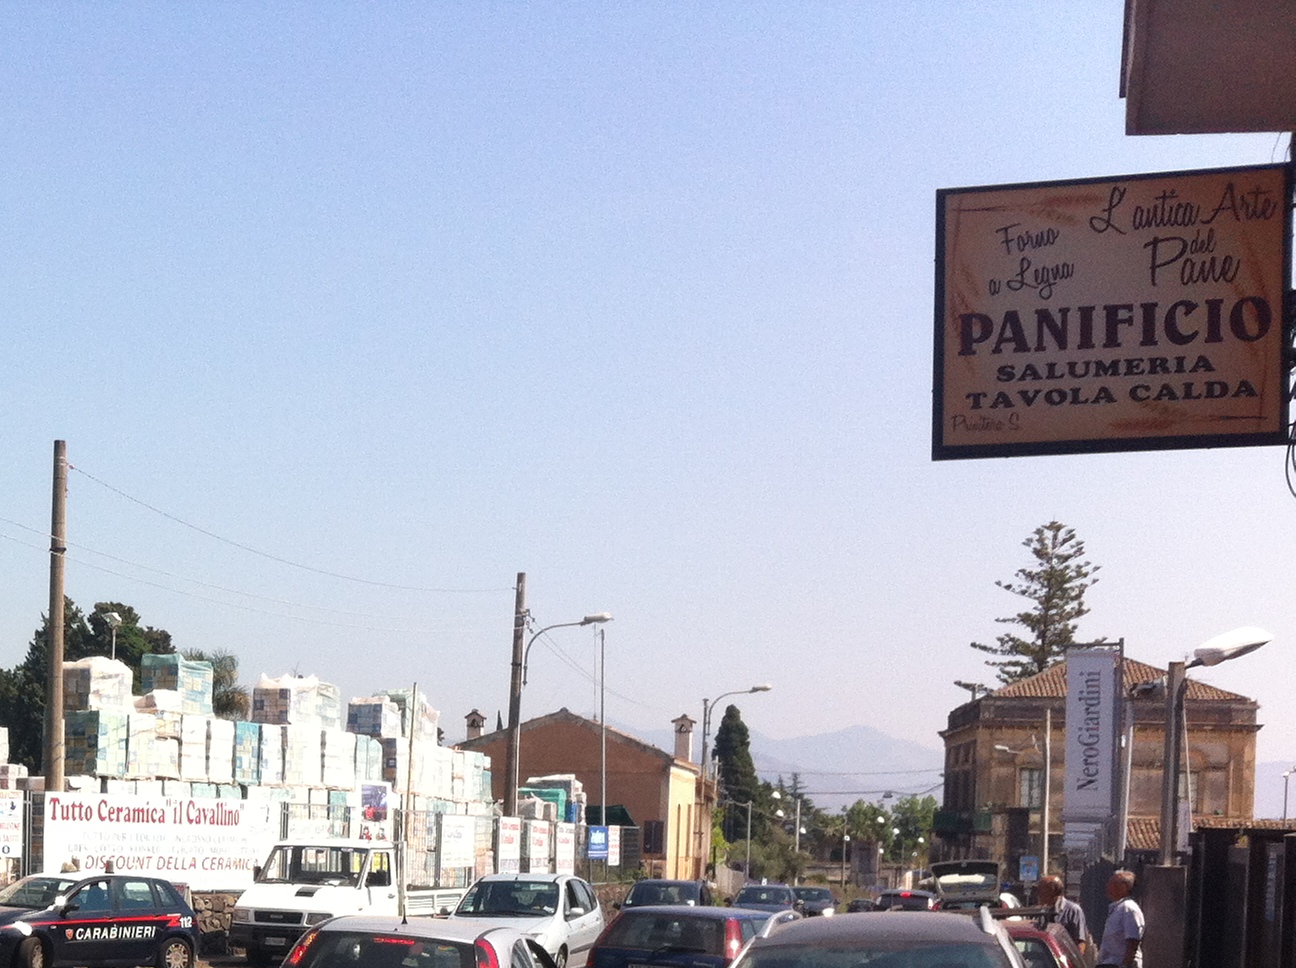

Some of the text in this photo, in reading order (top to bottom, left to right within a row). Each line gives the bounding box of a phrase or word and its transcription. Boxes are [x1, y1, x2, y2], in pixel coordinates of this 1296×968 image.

[1201, 182, 1276, 225] Arte
[996, 223, 1059, 254] Forno
[1190, 228, 1216, 254] del
[1144, 235, 1242, 287] Pane
[989, 257, 1074, 300] a Legna
[958, 296, 1273, 356] PANIFICIO
[997, 355, 1216, 382] SALUMERIA
[965, 379, 1259, 410] TAVOLA CALDA
[49, 797, 93, 821] Tutto
[98, 799, 166, 823] Ceramica
[157, 856, 196, 870] DELLA
[75, 926, 156, 940] CARABINIERI
[179, 916, 193, 928] 112
